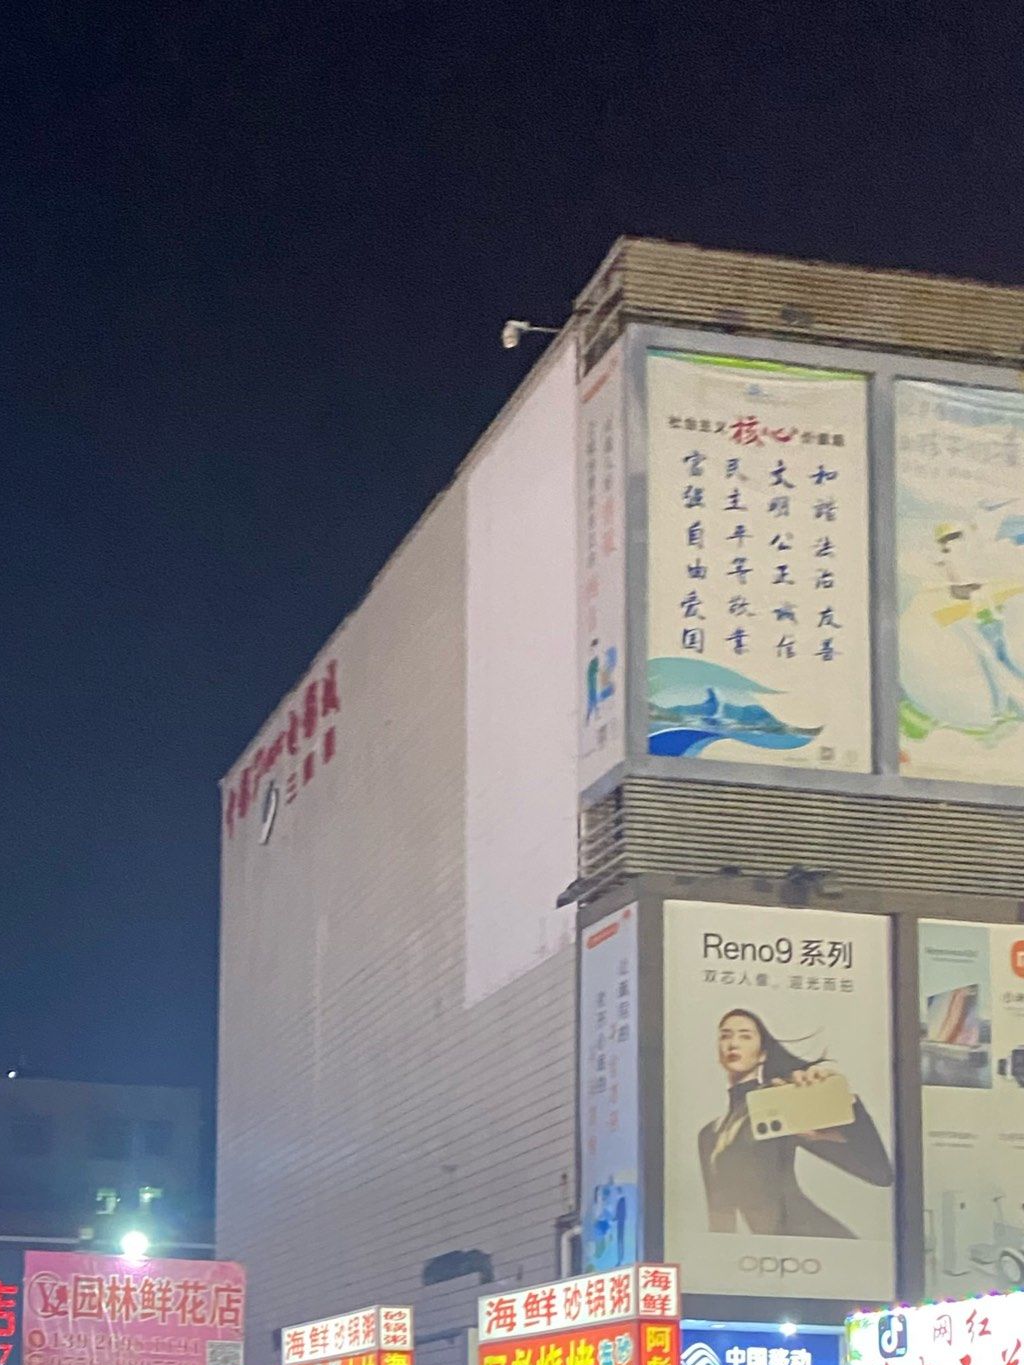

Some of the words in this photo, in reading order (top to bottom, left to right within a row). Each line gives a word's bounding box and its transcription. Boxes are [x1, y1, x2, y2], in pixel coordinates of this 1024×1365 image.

[703, 932, 793, 964] Reno9
[800, 939, 853, 970] 系列
[71, 1273, 244, 1329] 园林鲜花店
[484, 1273, 632, 1335] 海鲜砂锅粥
[640, 1269, 673, 1316] 海鲜
[285, 1312, 376, 1361] 海鲜砂锅粥
[383, 1310, 408, 1346] 砂锅粥
[933, 1309, 992, 1346] 网红
